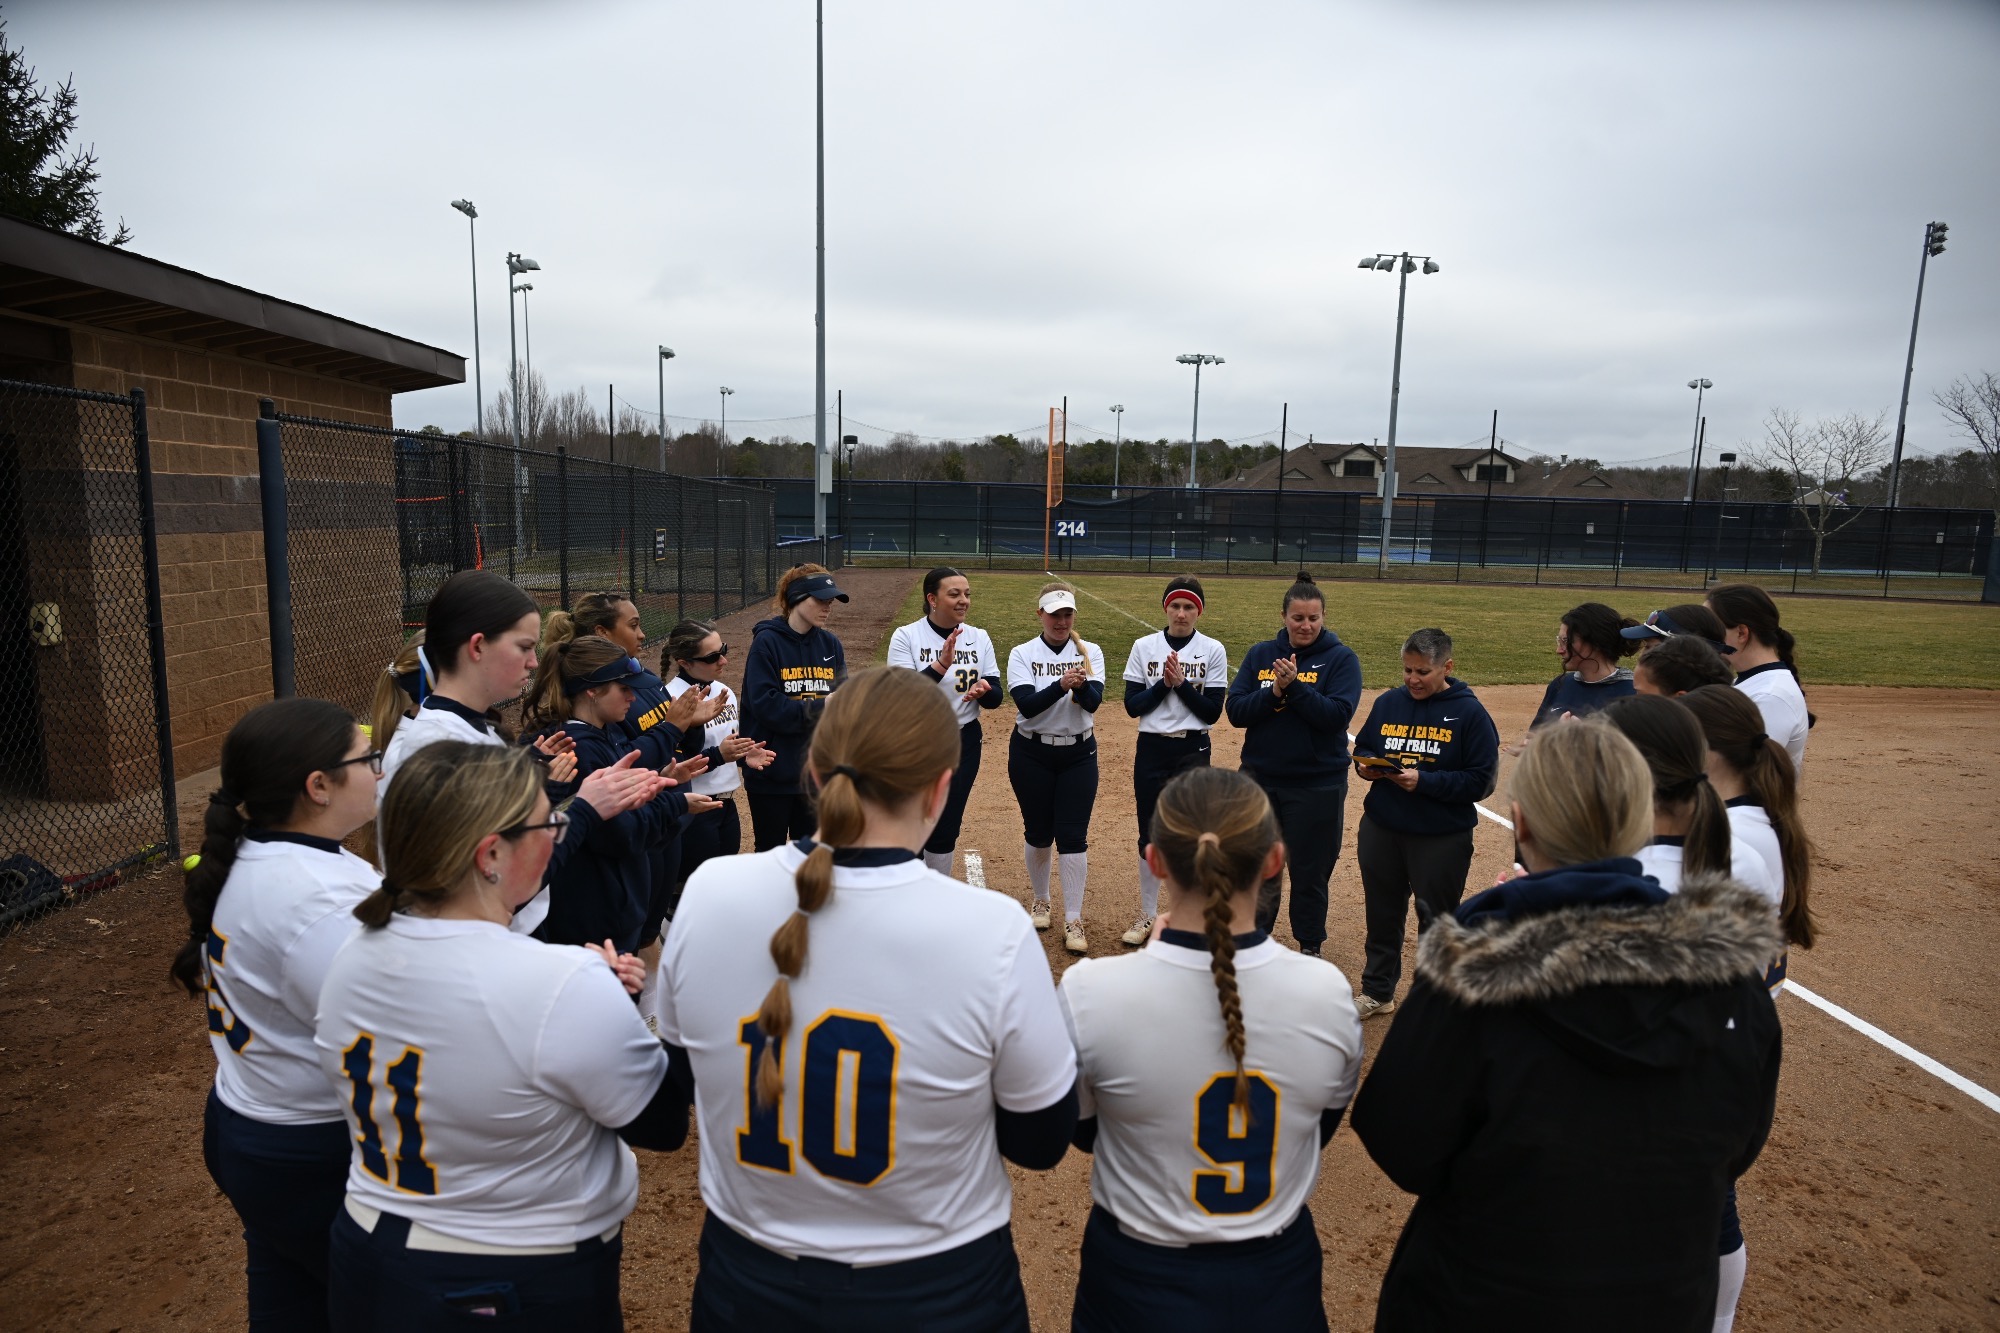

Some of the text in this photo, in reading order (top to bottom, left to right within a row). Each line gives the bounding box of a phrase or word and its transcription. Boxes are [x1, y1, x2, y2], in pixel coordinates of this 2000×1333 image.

[1057, 521, 1086, 537] 214
[920, 648, 978, 665] ST. JEPH'S
[1032, 661, 1044, 677] ST.
[1148, 662, 1206, 678] ST. JEPH'S
[784, 680, 830, 693] SOFTBALL
[1415, 725, 1453, 743] EAGLES
[1384, 737, 1441, 755] SOFTBALL
[736, 1008, 900, 1188] 10
[341, 1031, 439, 1196] 11
[1191, 1069, 1281, 1217] 9
